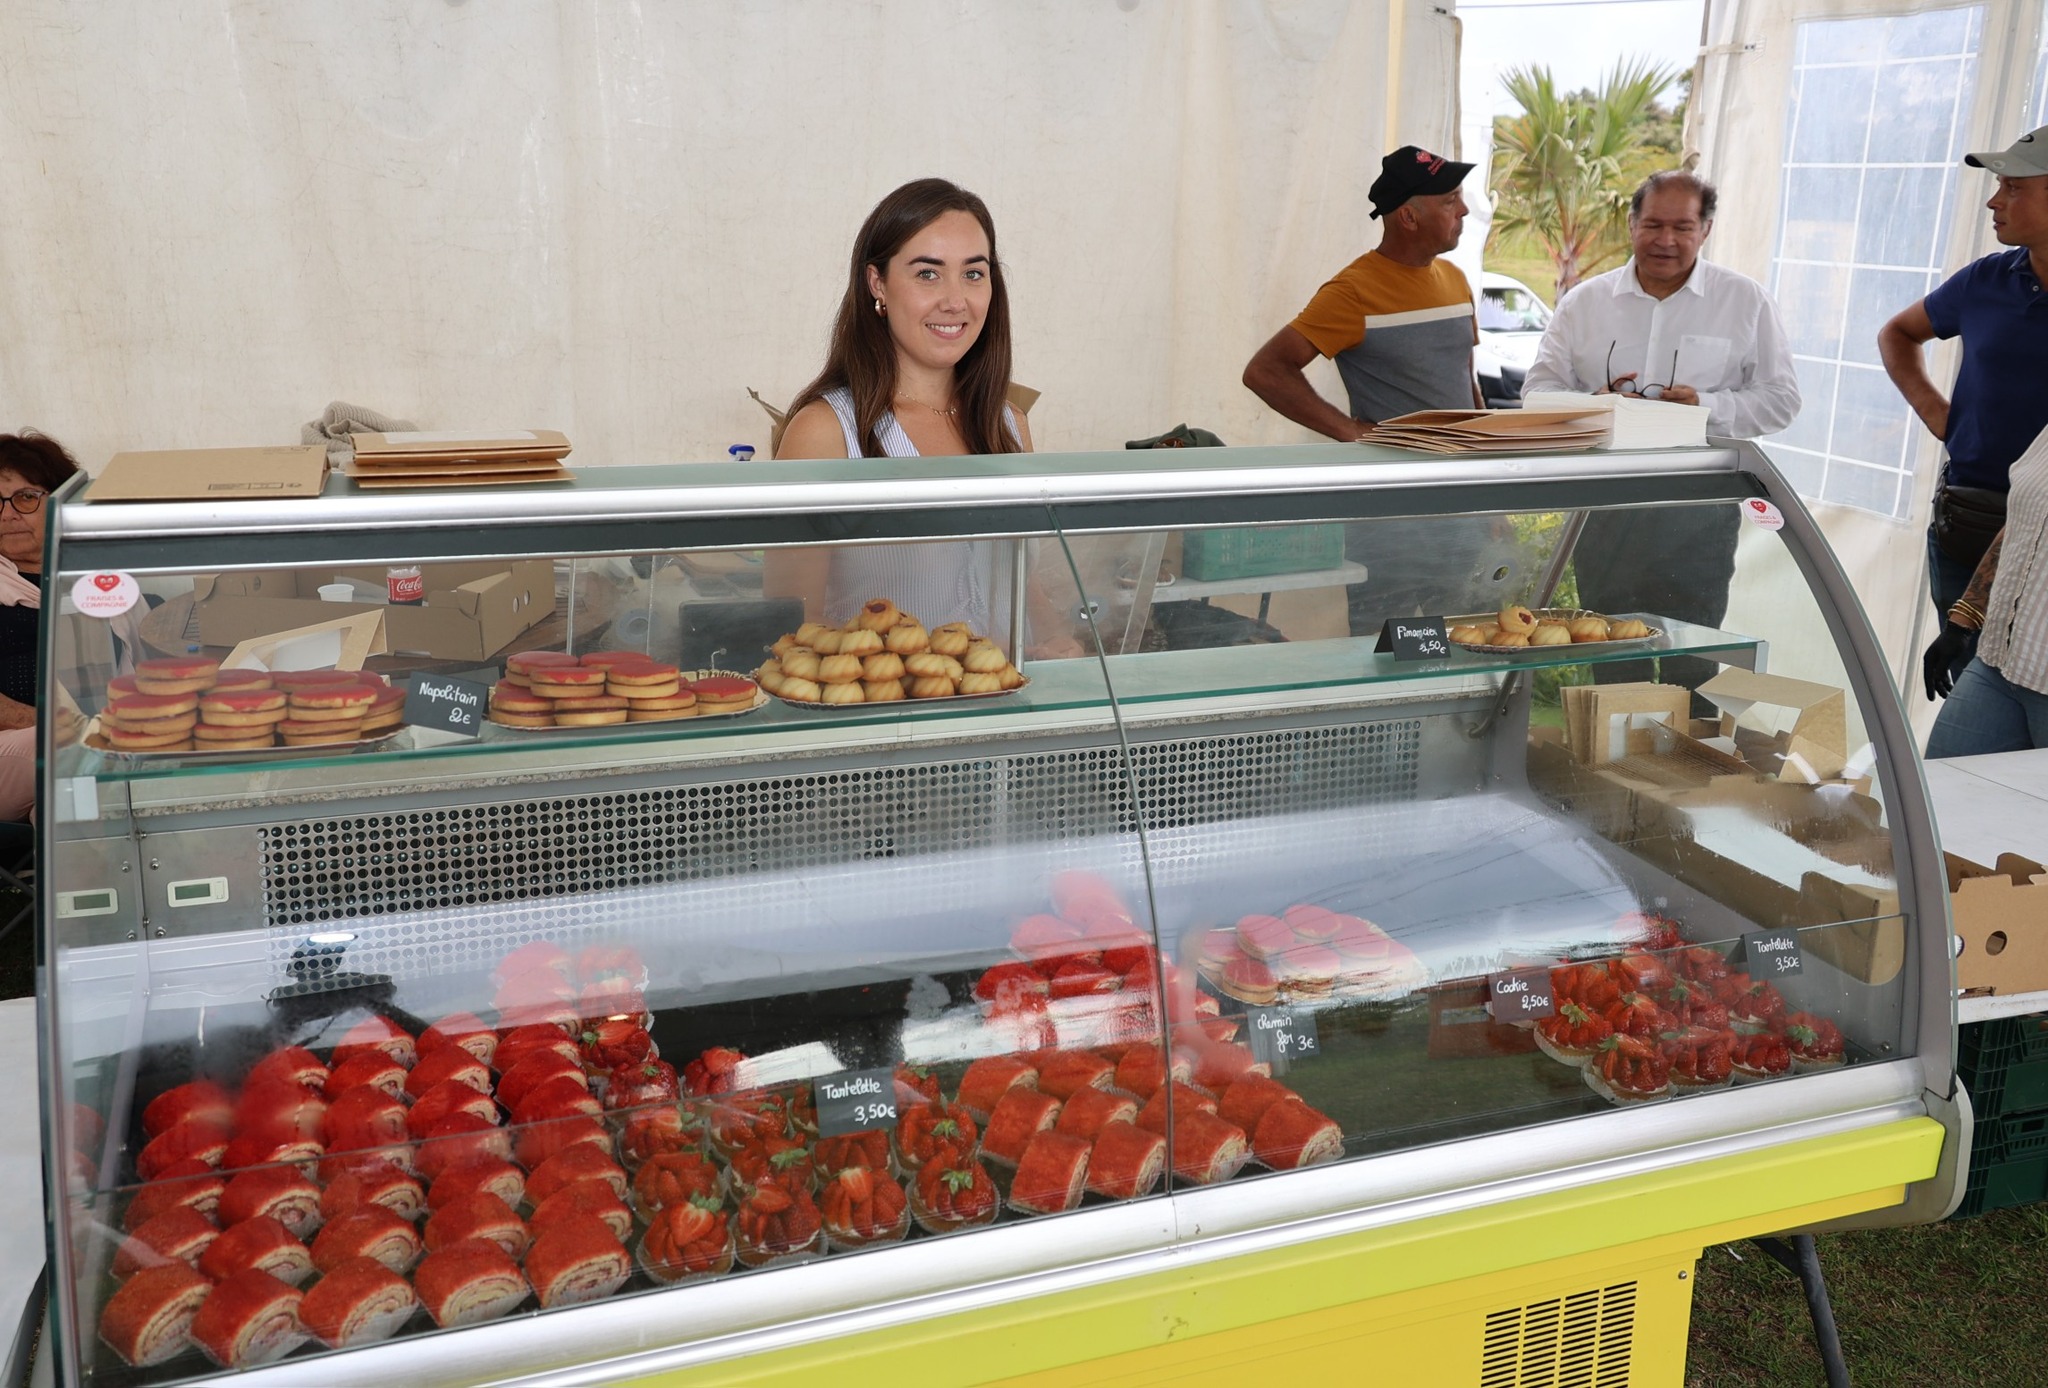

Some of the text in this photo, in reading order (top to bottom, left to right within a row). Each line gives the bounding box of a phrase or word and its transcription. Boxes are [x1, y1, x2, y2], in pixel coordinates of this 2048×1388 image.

[418, 681, 478, 707] Napolitain
[448, 706, 471, 725] 2€
[1752, 937, 1795, 954] Tartelette
[1775, 955, 1801, 973] 3,50€
[1496, 976, 1530, 994] Cookie
[1521, 994, 1550, 1012] 2,50€
[1297, 1034, 1315, 1051] 3€
[820, 1077, 883, 1100] Tartelette
[853, 1103, 897, 1126] 3,50€
